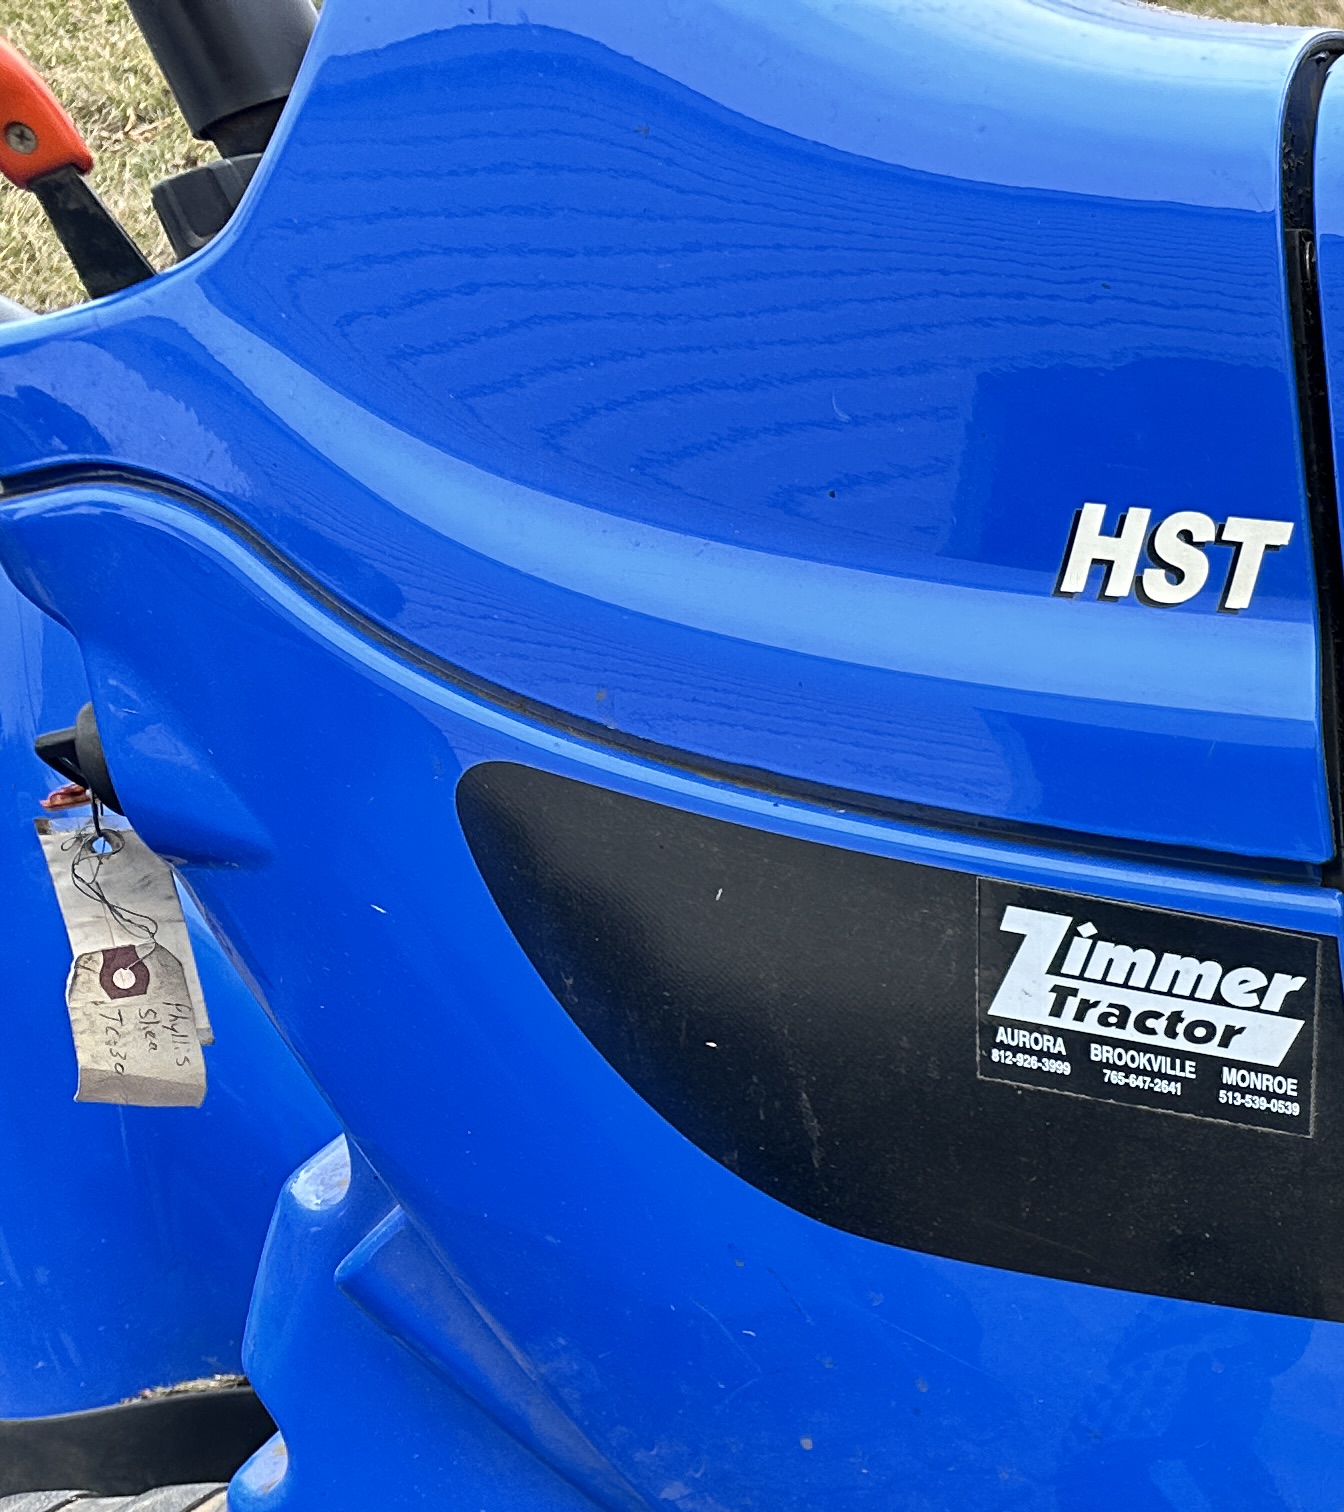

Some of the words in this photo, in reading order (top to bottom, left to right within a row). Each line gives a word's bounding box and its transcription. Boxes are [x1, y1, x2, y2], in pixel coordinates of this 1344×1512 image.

[1053, 502, 1295, 614] HST
[988, 904, 1307, 1018] Zimmer
[1048, 983, 1248, 1050] Tractor
[991, 1049, 1072, 1076] 812-926-3999
[1102, 1068, 1182, 1096] 765-647-2641
[1218, 1089, 1301, 1117] 513-539-0539
[995, 1026, 1067, 1056] AURORA
[1090, 1042, 1197, 1079] BROOKVILLE
[1222, 1066, 1299, 1097] MONROE
